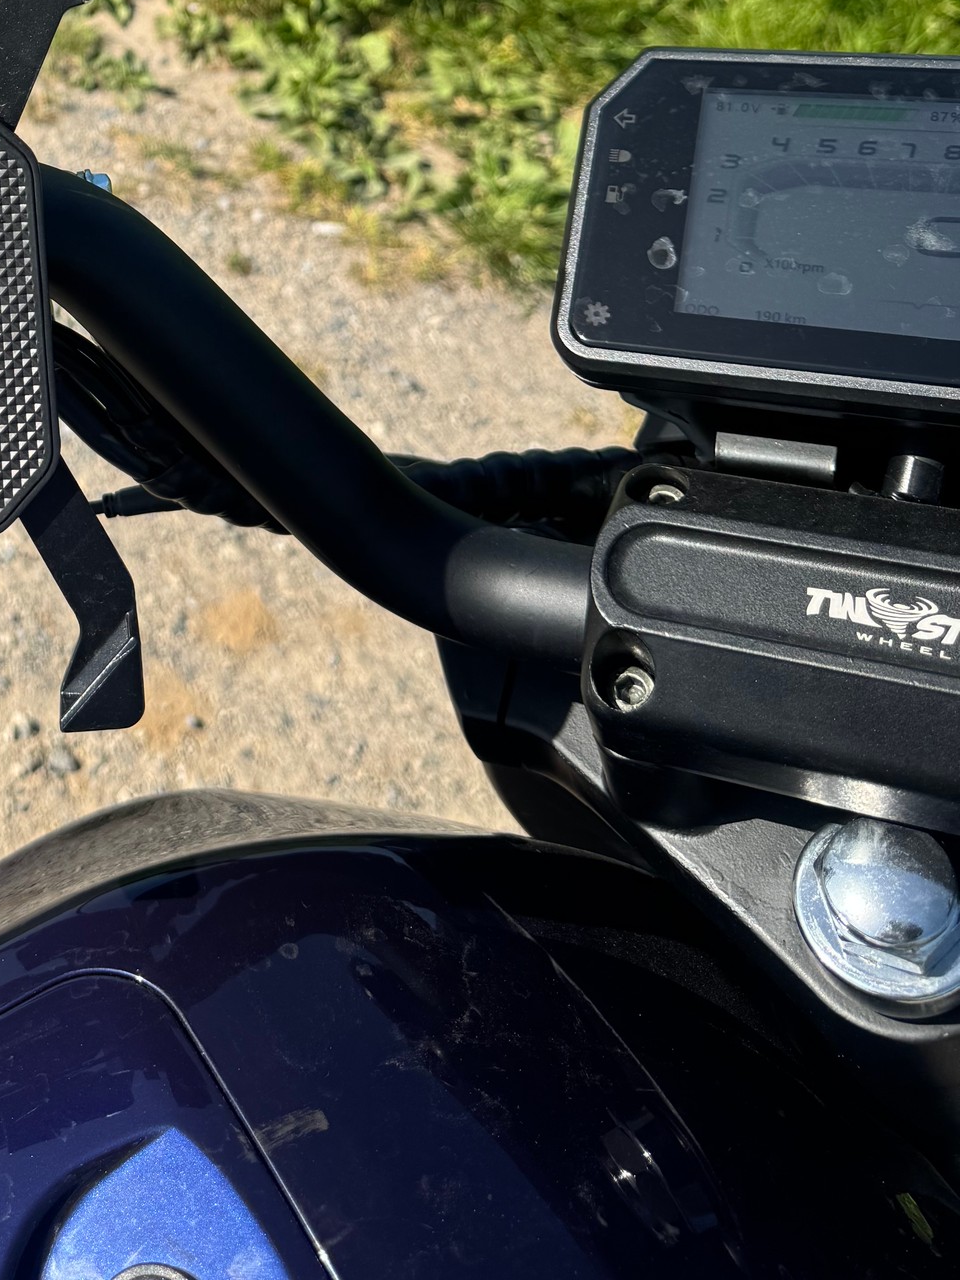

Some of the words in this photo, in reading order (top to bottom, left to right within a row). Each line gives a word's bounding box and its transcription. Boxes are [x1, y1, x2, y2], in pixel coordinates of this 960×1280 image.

[716, 101, 761, 115] 81.0V
[772, 136, 791, 152] 4
[816, 138, 838, 154] 5
[857, 140, 878, 156] 6
[901, 142, 917, 158] 7
[721, 153, 742, 169] 3
[706, 188, 728, 204] 2
[755, 309, 782, 322] 190
